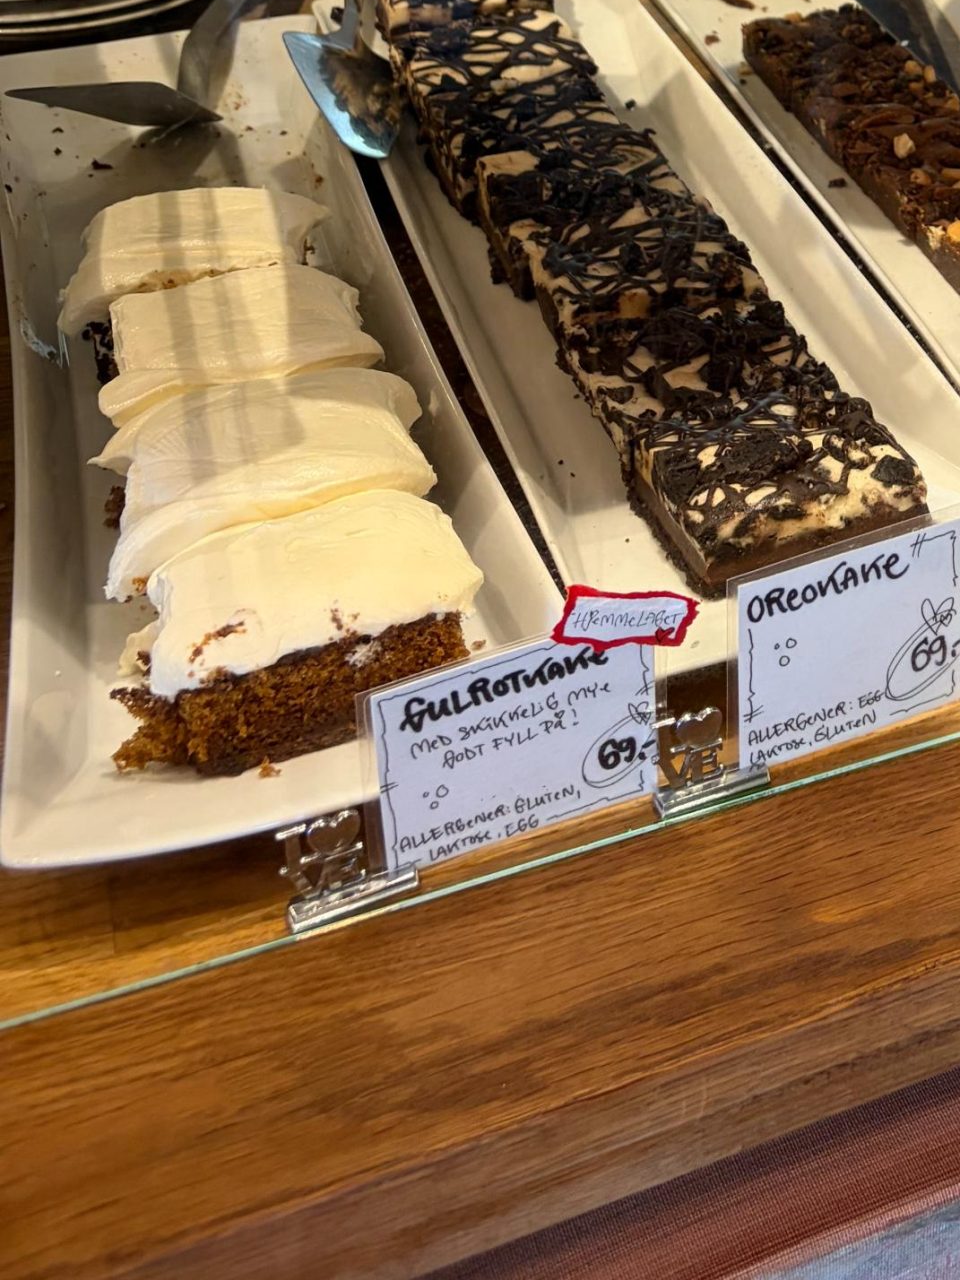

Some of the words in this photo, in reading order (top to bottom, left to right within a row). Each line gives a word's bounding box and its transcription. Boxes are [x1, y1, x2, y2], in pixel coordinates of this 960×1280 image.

[858, 690, 883, 709] EGG
[492, 728, 539, 750] FYLL
[505, 814, 540, 837] EGG
